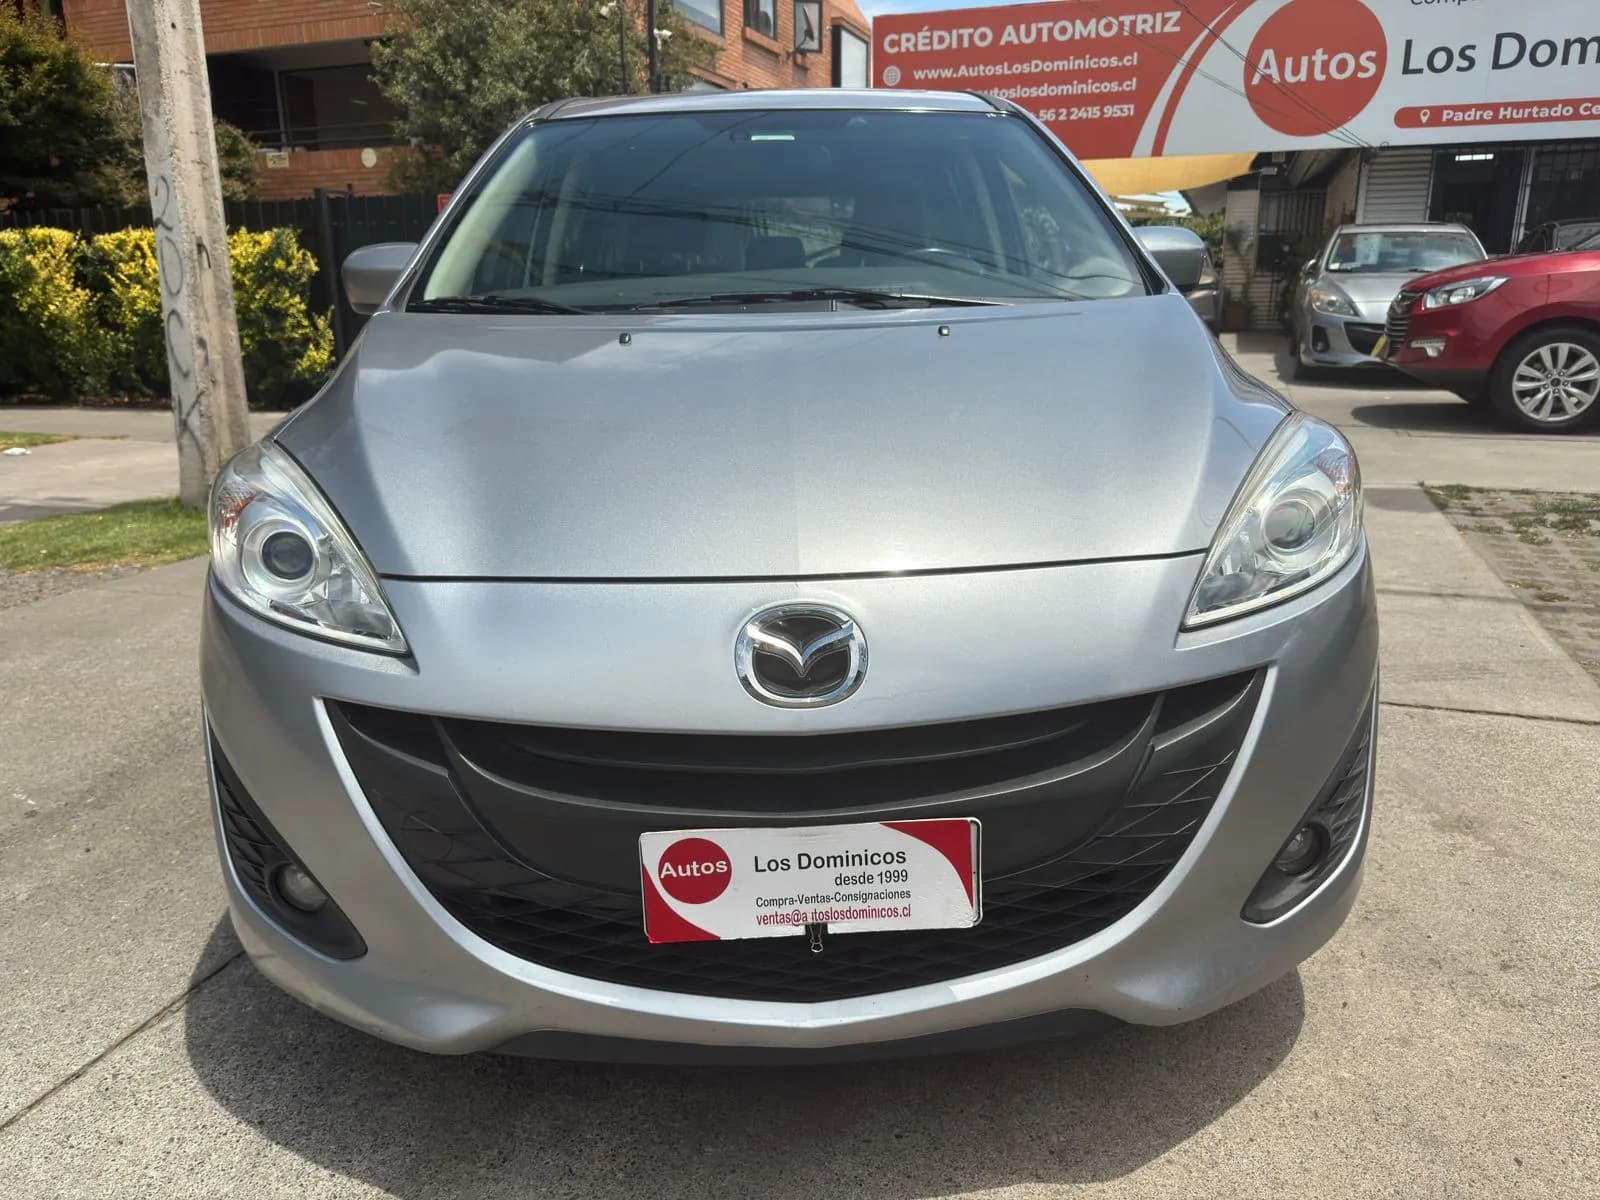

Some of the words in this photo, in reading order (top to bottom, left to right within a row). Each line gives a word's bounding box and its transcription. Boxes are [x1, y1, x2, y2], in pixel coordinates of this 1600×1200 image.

[883, 26, 993, 54] CRÉDITO
[1001, 11, 1182, 46] AUTOMOTRIZ
[1402, 39, 1477, 75] Los
[1491, 32, 1600, 71] Dom
[913, 52, 1138, 81] www.AutosLosDominicos.cl
[1252, 48, 1377, 86] Autos
[1058, 107, 1068, 121] 2
[1070, 106, 1101, 121] 2415
[1104, 104, 1135, 119] 9531
[1442, 108, 1493, 123] Padre
[1499, 104, 1574, 121] Hurtado
[660, 857, 728, 879] Autos
[754, 854, 791, 873] Los
[798, 848, 907, 871] Dominicos
[834, 872, 875, 887] desde
[878, 869, 909, 884] 1999
[755, 889, 911, 910] Compra-Ventas-Consignaciones
